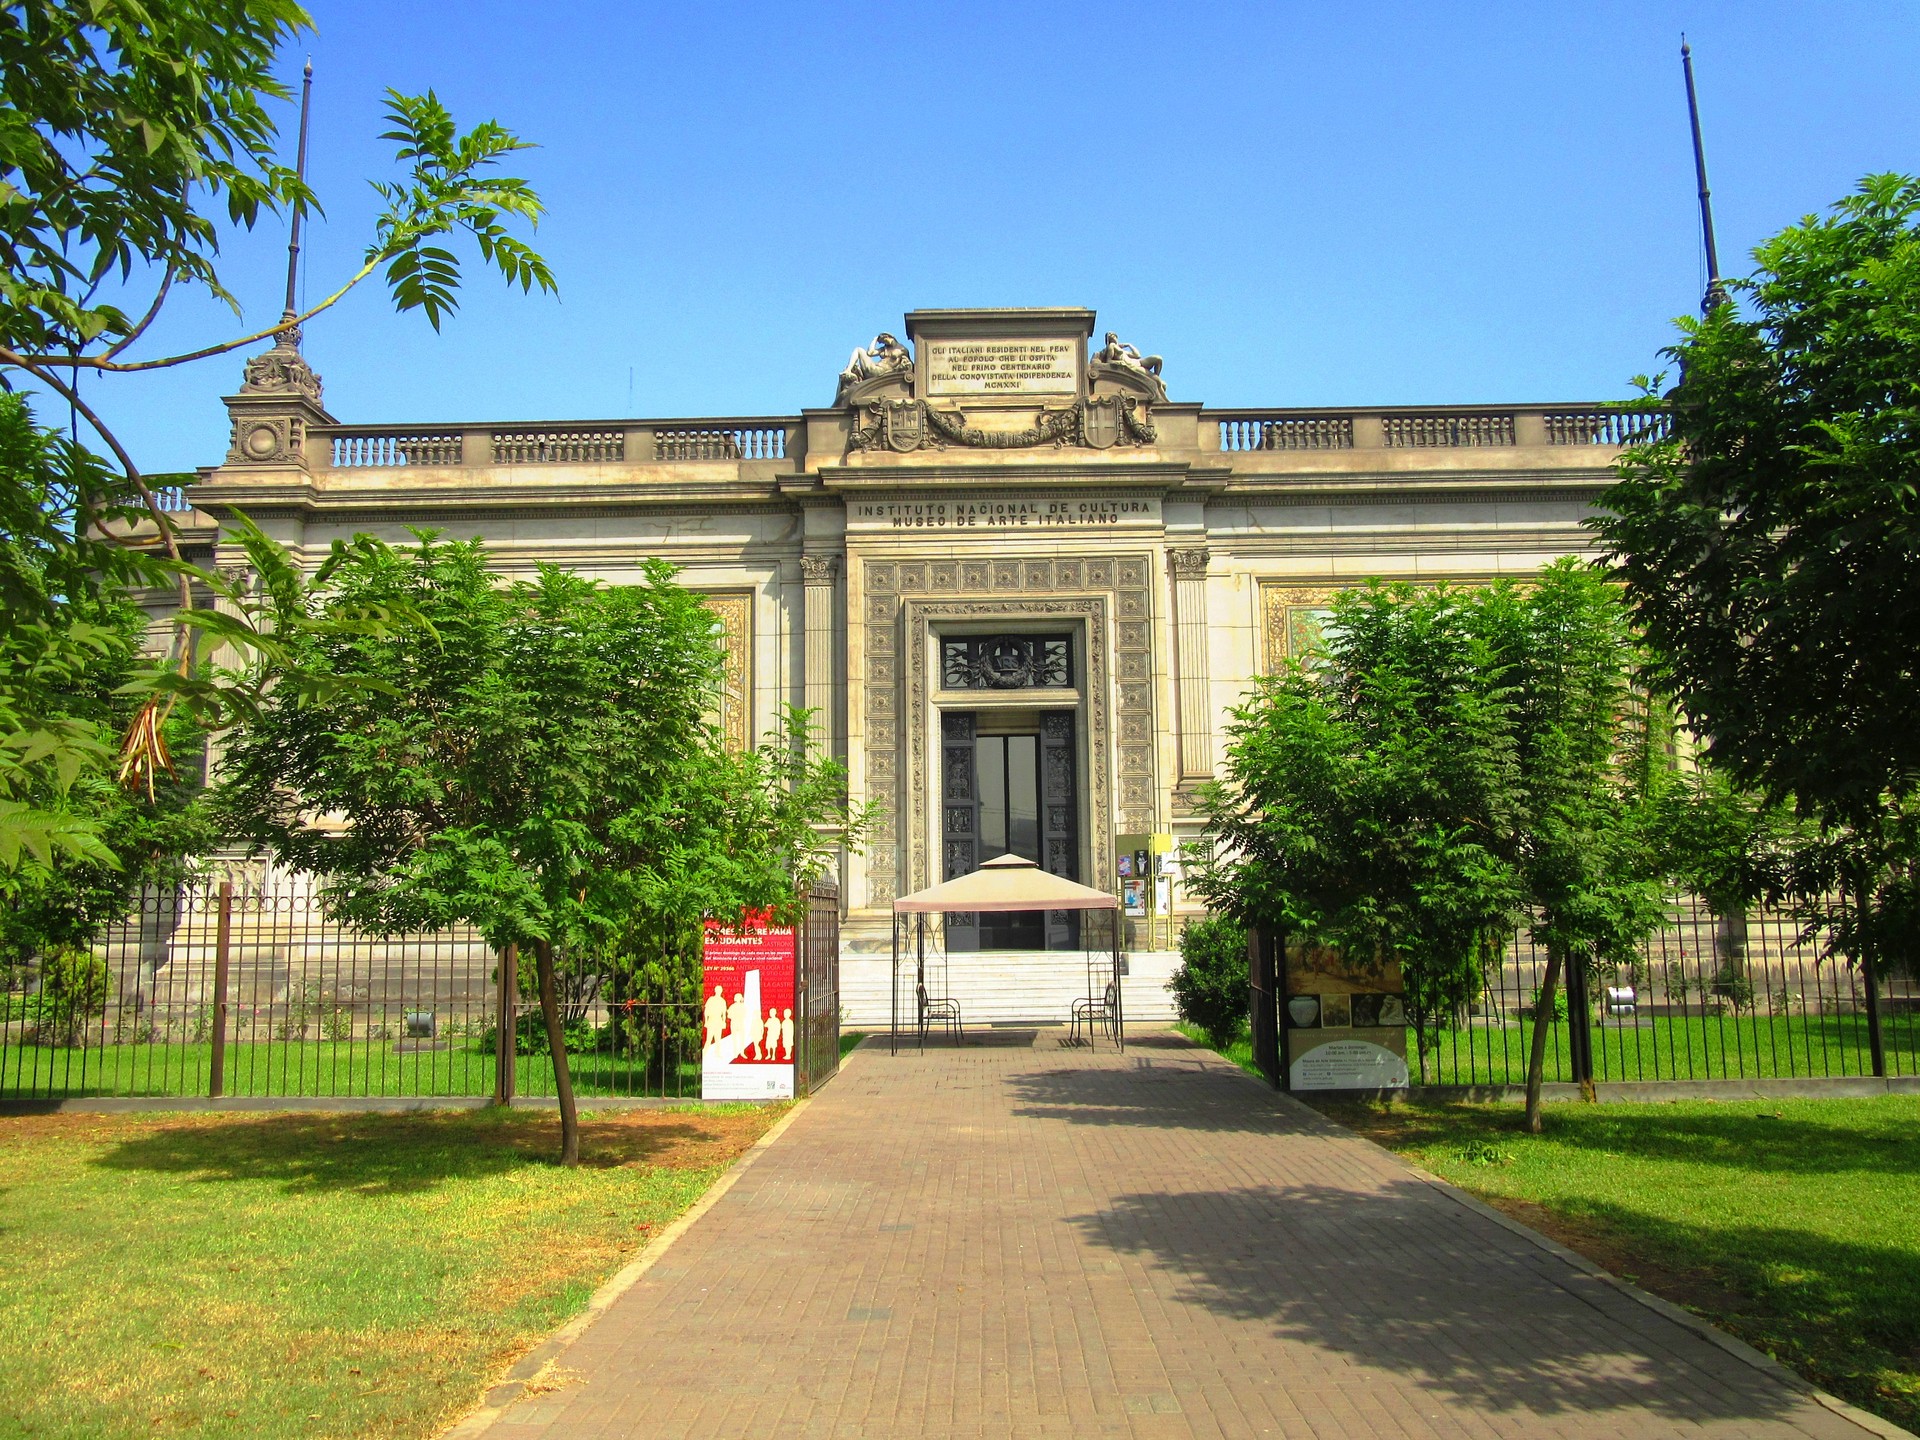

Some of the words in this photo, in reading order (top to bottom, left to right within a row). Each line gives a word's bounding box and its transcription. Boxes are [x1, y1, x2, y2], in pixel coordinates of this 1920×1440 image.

[949, 346, 982, 354] ITALIANI
[859, 504, 946, 516] INSTITUTO
[957, 503, 1038, 515] NACIONAL
[1049, 503, 1069, 514] DE
[1080, 502, 1150, 513] CULTURA
[893, 517, 946, 528] MUSEO
[957, 516, 976, 527] DE
[988, 515, 1028, 526] ARTE
[1039, 514, 1119, 525] ITALIANO
